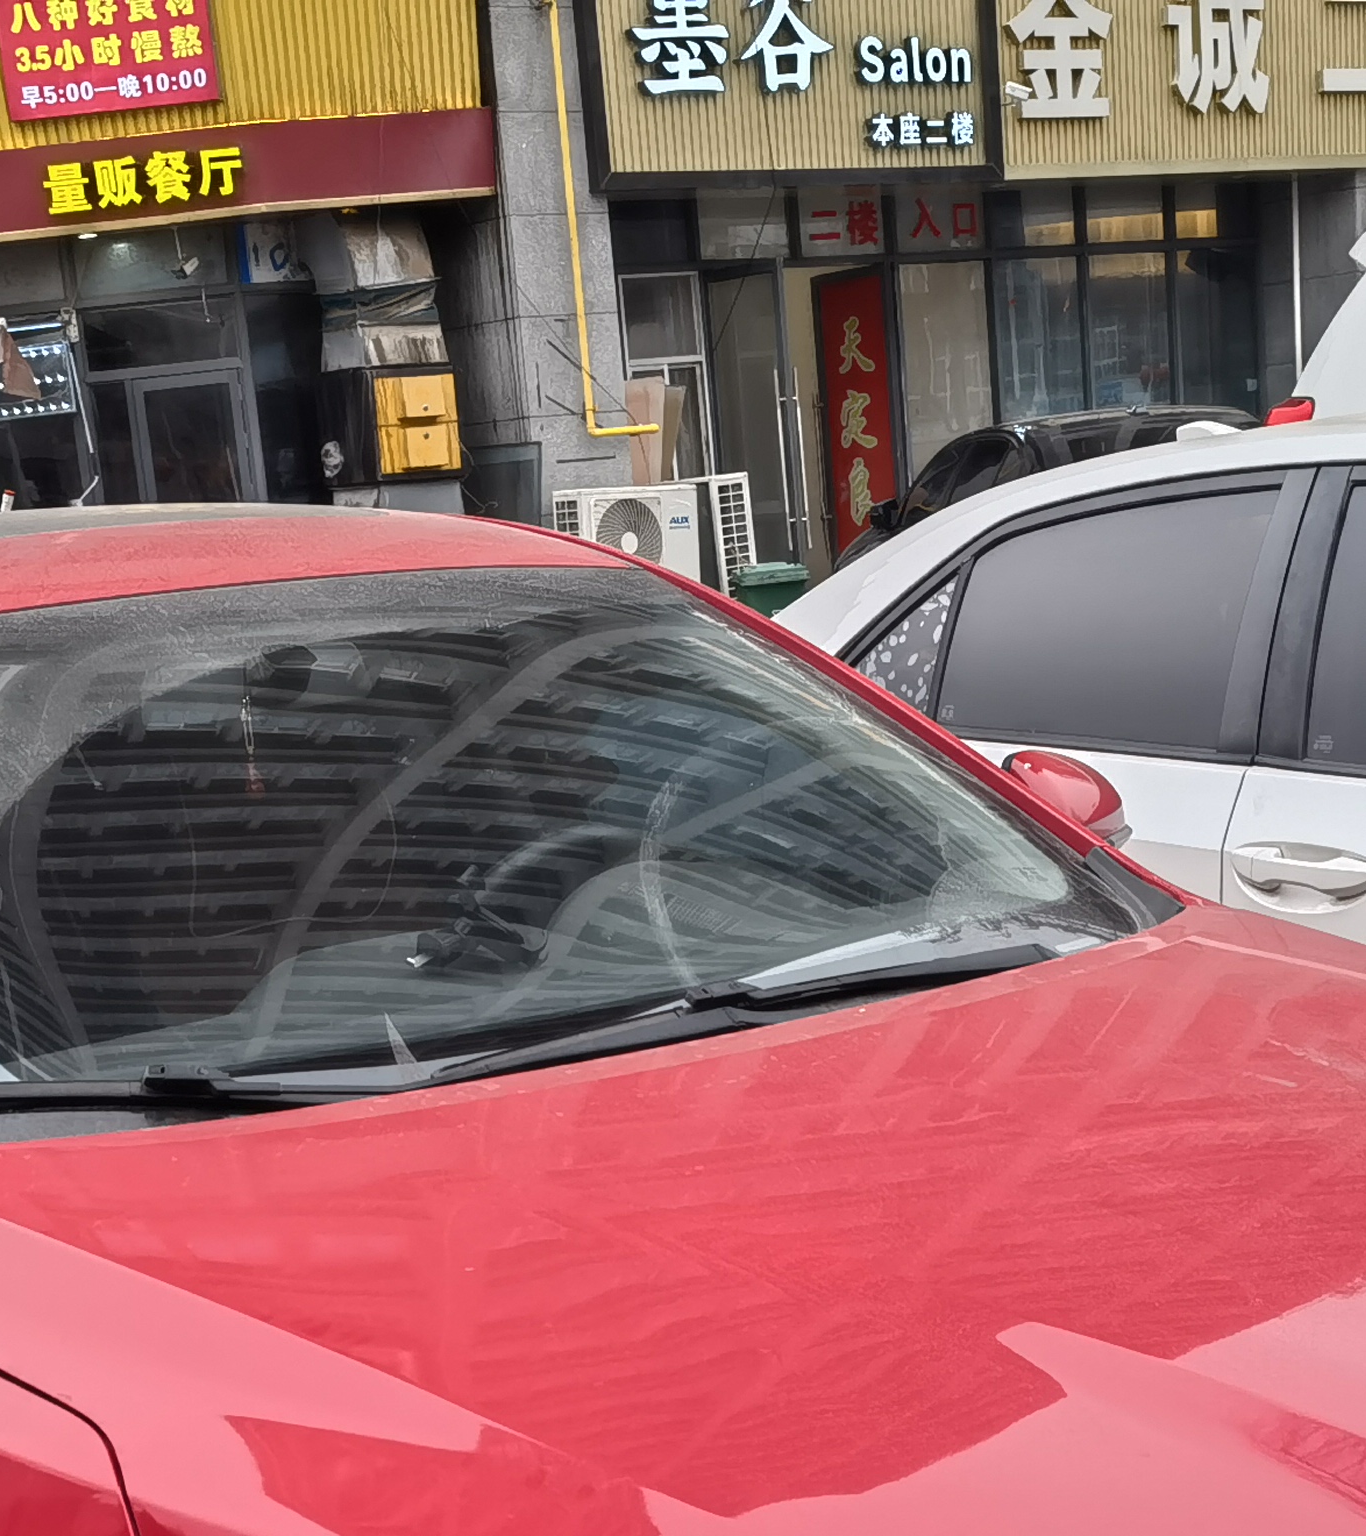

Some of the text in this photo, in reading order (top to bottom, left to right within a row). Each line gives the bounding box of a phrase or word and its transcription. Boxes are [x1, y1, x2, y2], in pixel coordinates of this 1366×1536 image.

[15, 23, 204, 73] 3.5小时慢熬
[859, 36, 973, 86] Salon
[871, 112, 975, 147] 本座二楼
[43, 146, 243, 217] 量贩餐厅
[809, 198, 978, 246] 二楼 入口
[669, 516, 690, 525] AUX
